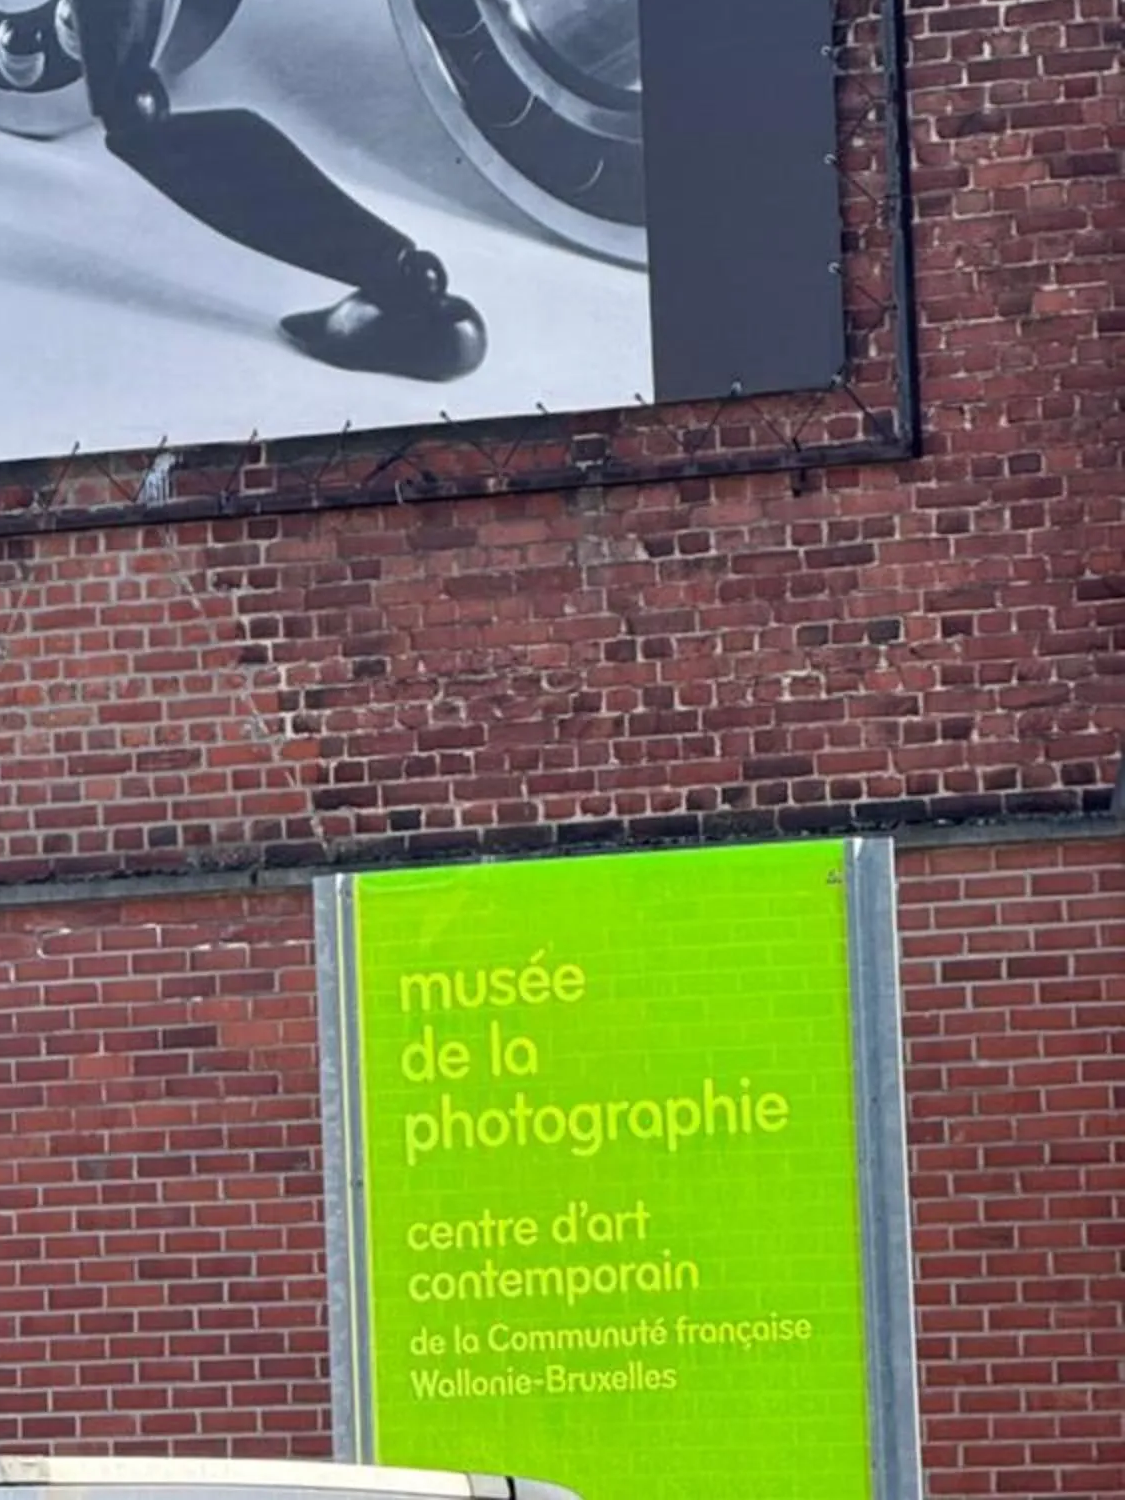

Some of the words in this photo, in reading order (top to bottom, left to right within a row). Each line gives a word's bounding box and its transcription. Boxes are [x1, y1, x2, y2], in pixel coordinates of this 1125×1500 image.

[399, 949, 585, 1011] musée
[401, 1025, 470, 1083] de
[491, 1021, 538, 1076] la
[405, 1077, 789, 1165] photographie
[406, 1209, 538, 1250] centre
[551, 1200, 651, 1244] d'art
[408, 1250, 699, 1305] contemporain
[409, 1328, 446, 1356] de
[455, 1325, 480, 1354] la
[675, 1313, 813, 1350] française
[409, 1362, 677, 1400] Wallonie-Bruxelles
